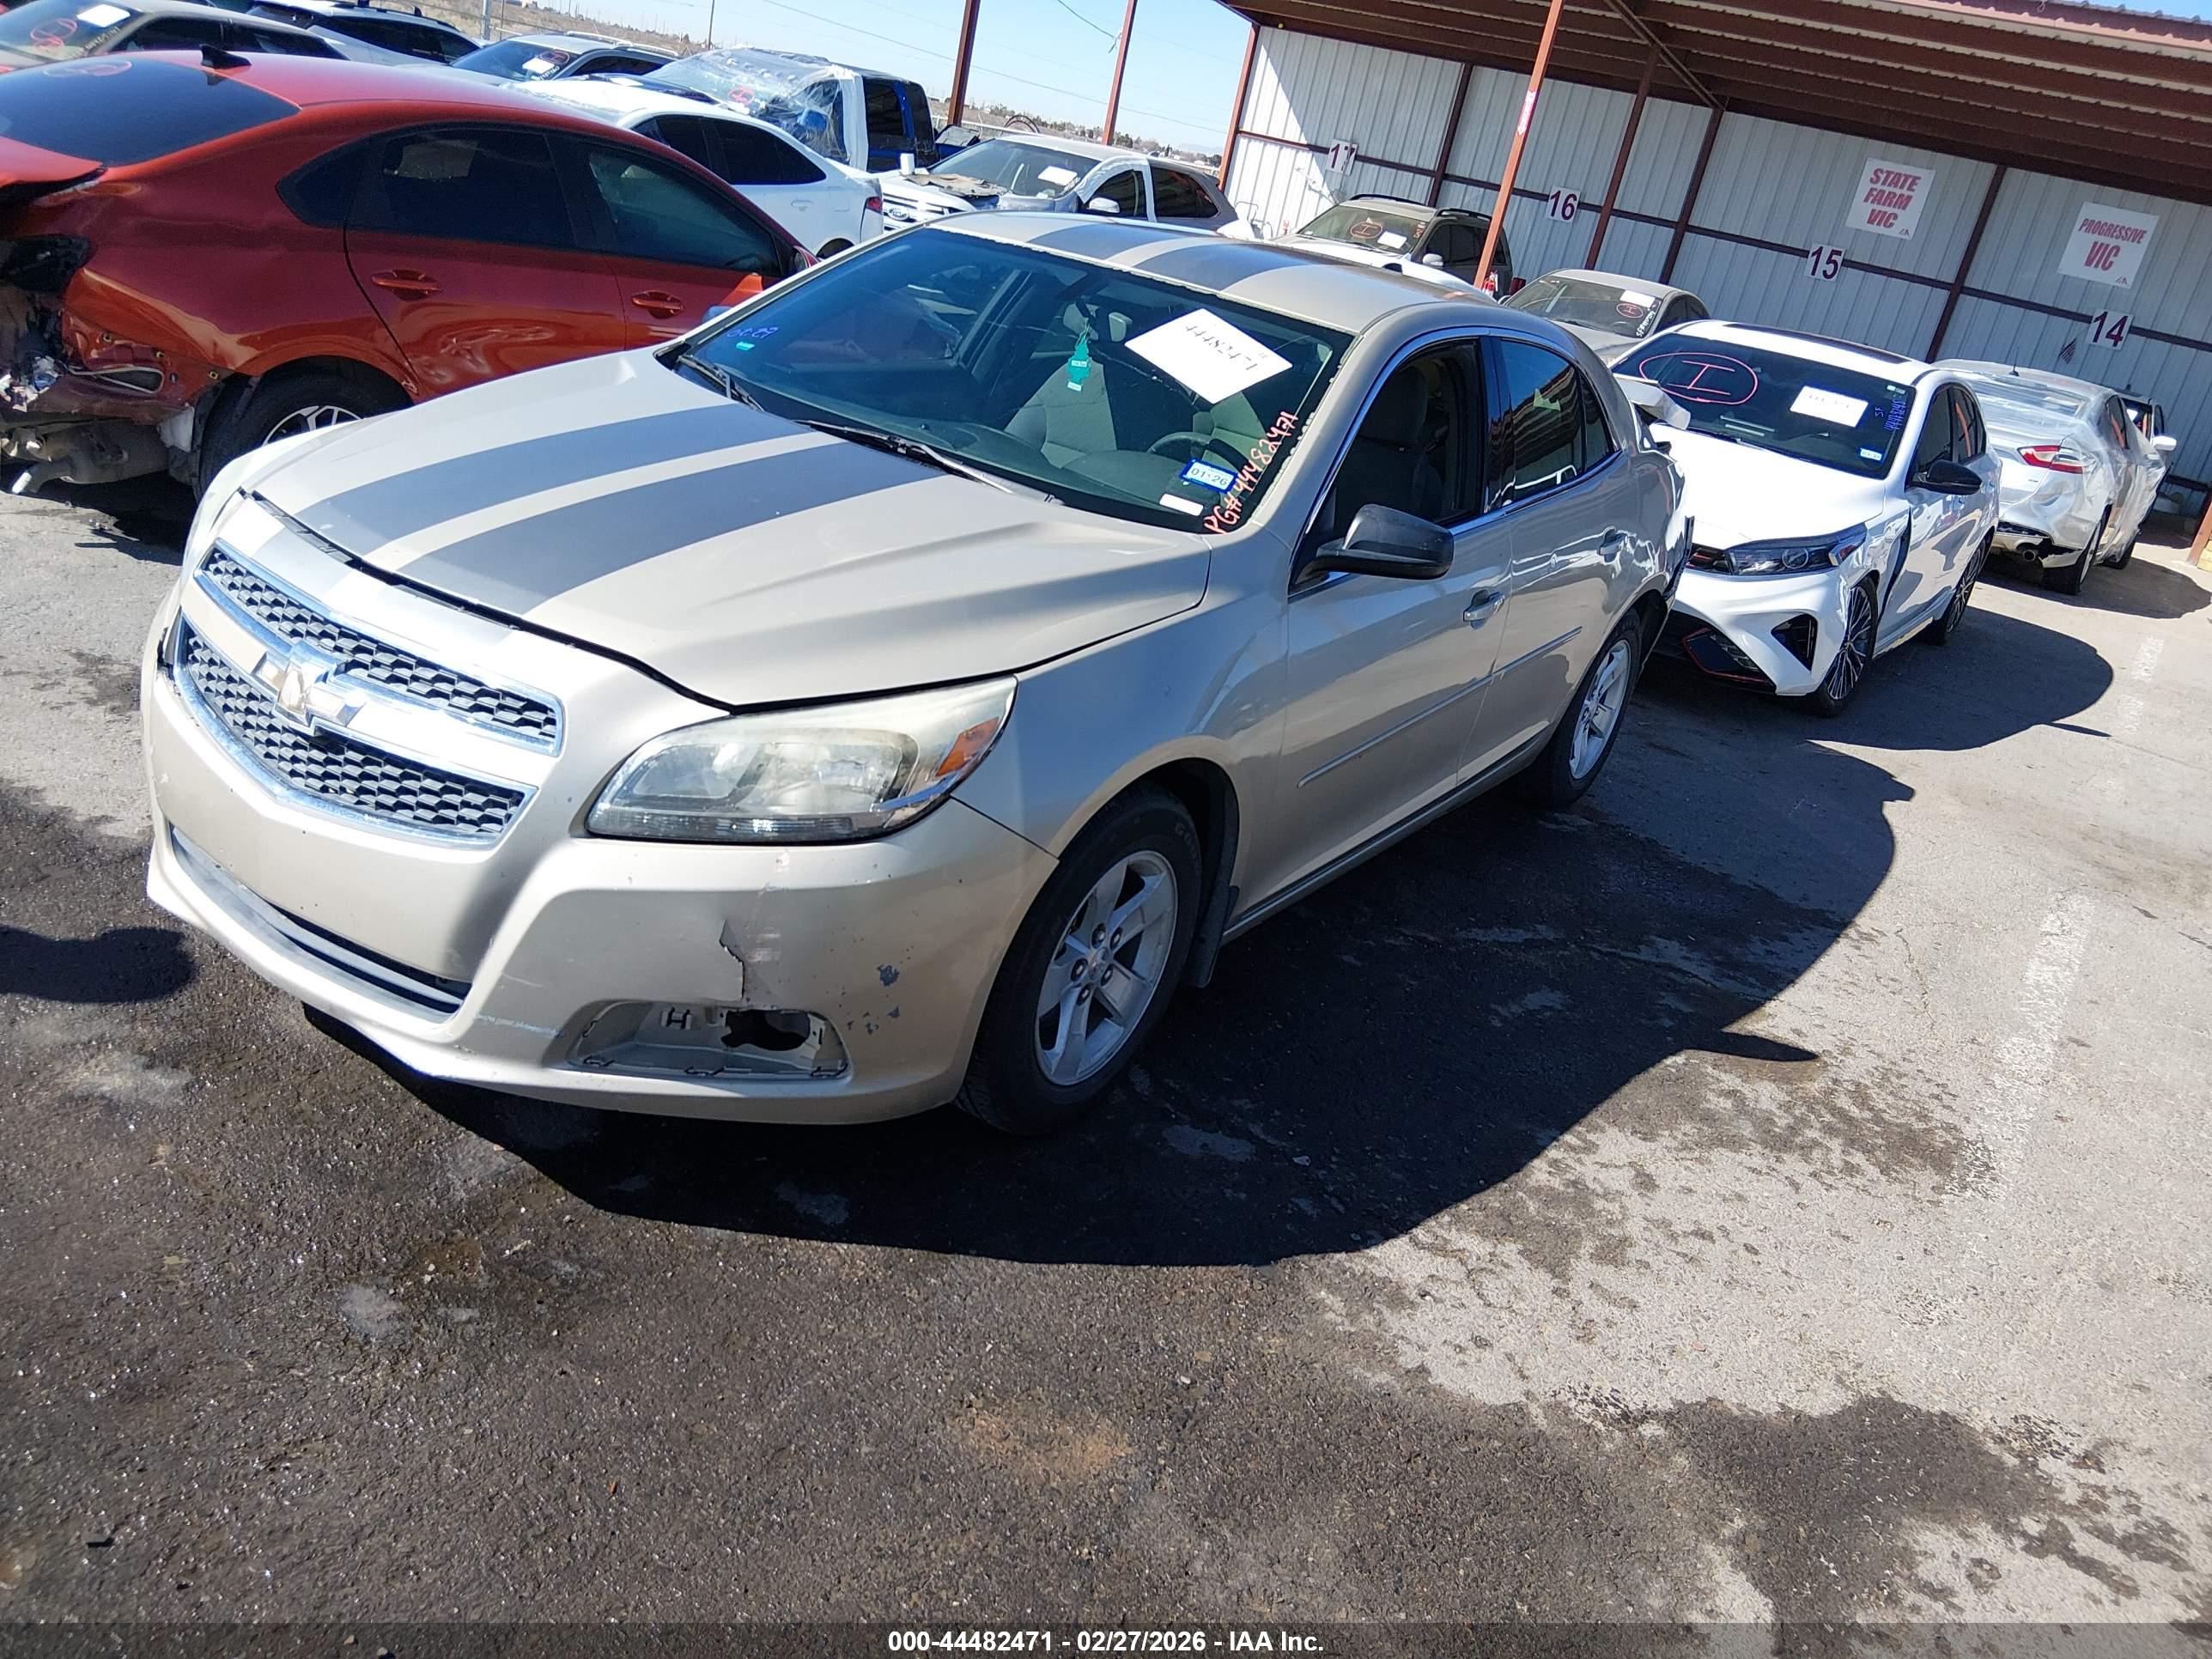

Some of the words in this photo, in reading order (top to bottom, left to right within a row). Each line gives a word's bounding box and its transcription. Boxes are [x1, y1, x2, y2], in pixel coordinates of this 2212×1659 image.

[1331, 143, 1356, 172] 17
[1869, 167, 1923, 192] STATE
[1550, 190, 1577, 221] 16
[1863, 187, 1914, 210] FARM
[1866, 208, 1899, 228] VIC
[2078, 217, 2148, 244] PROGRESSIVE
[1810, 246, 1843, 280] 15
[2083, 240, 2121, 271] VIC
[2093, 311, 2129, 347] 14
